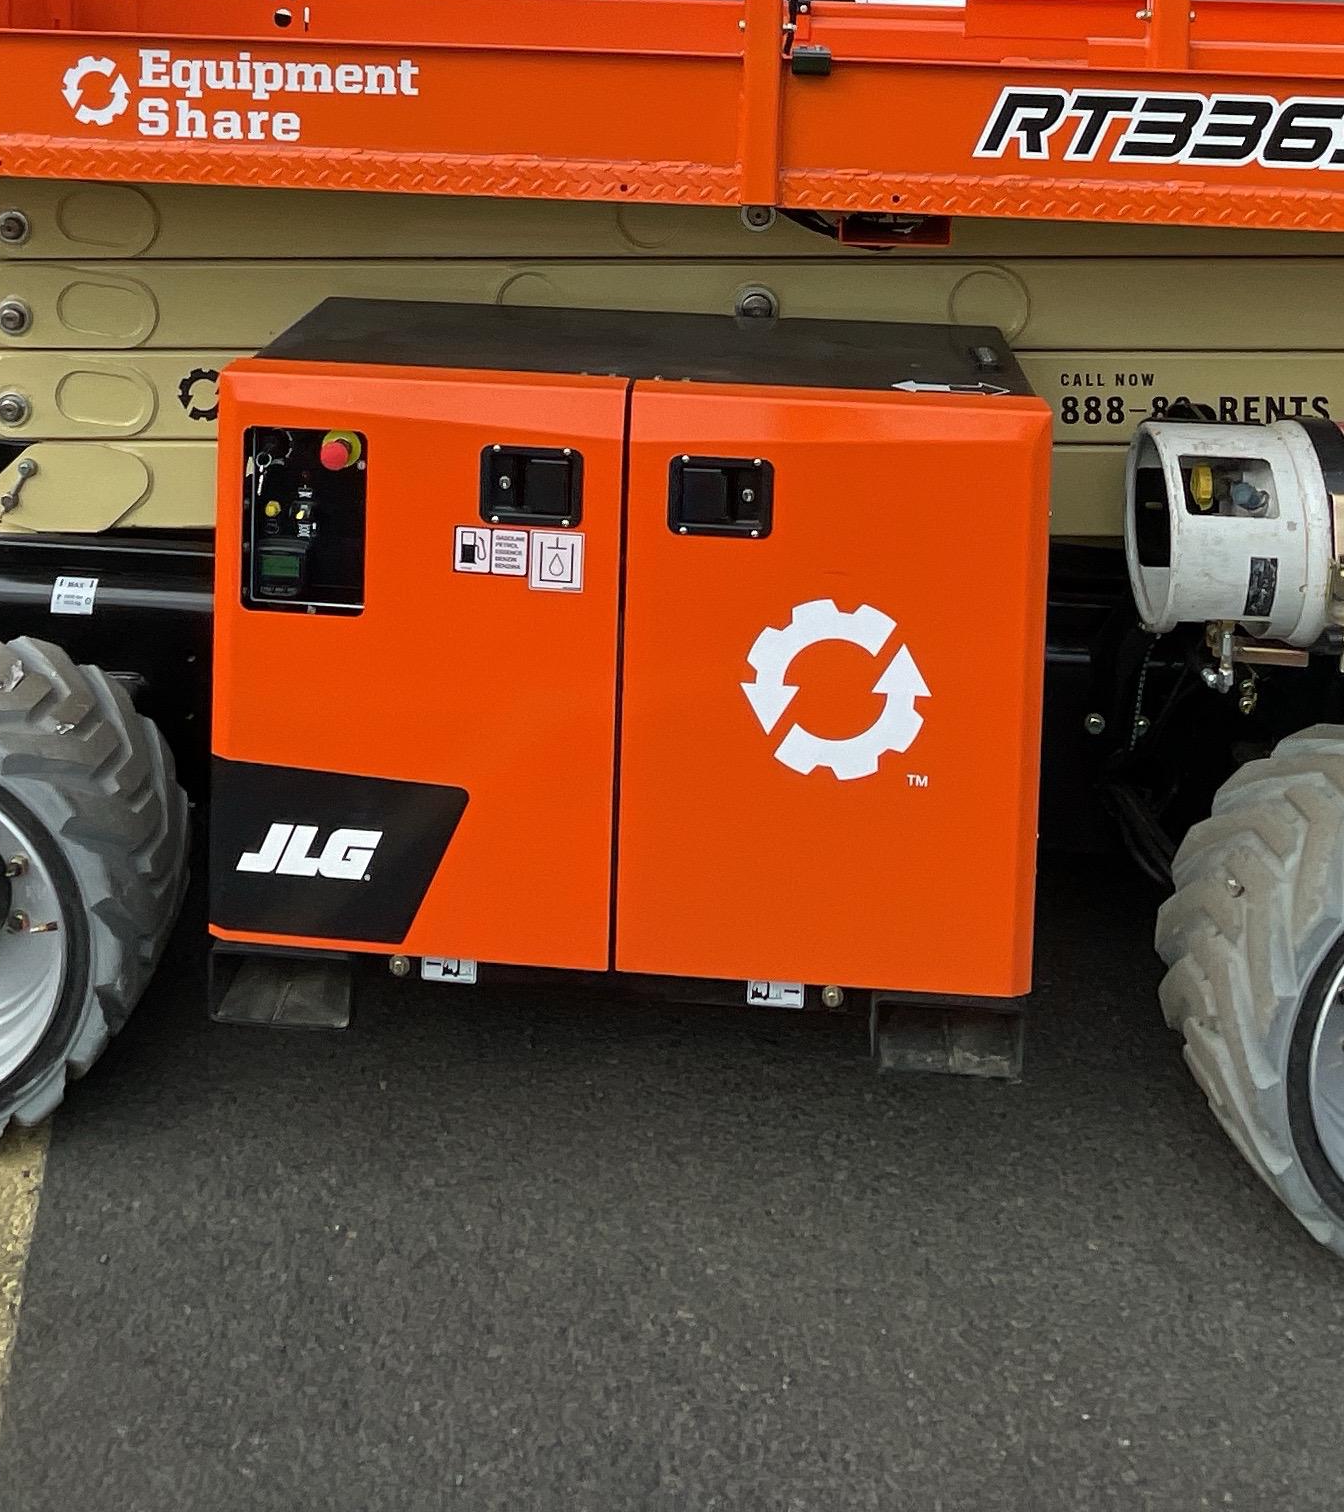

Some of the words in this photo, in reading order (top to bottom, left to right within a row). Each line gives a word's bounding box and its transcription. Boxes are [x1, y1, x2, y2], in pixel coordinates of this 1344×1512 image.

[138, 48, 420, 100] Equipment
[137, 97, 301, 142] Share
[1060, 373, 1105, 387] CALL
[1115, 373, 1155, 387] NOW
[235, 822, 384, 881] JLG
